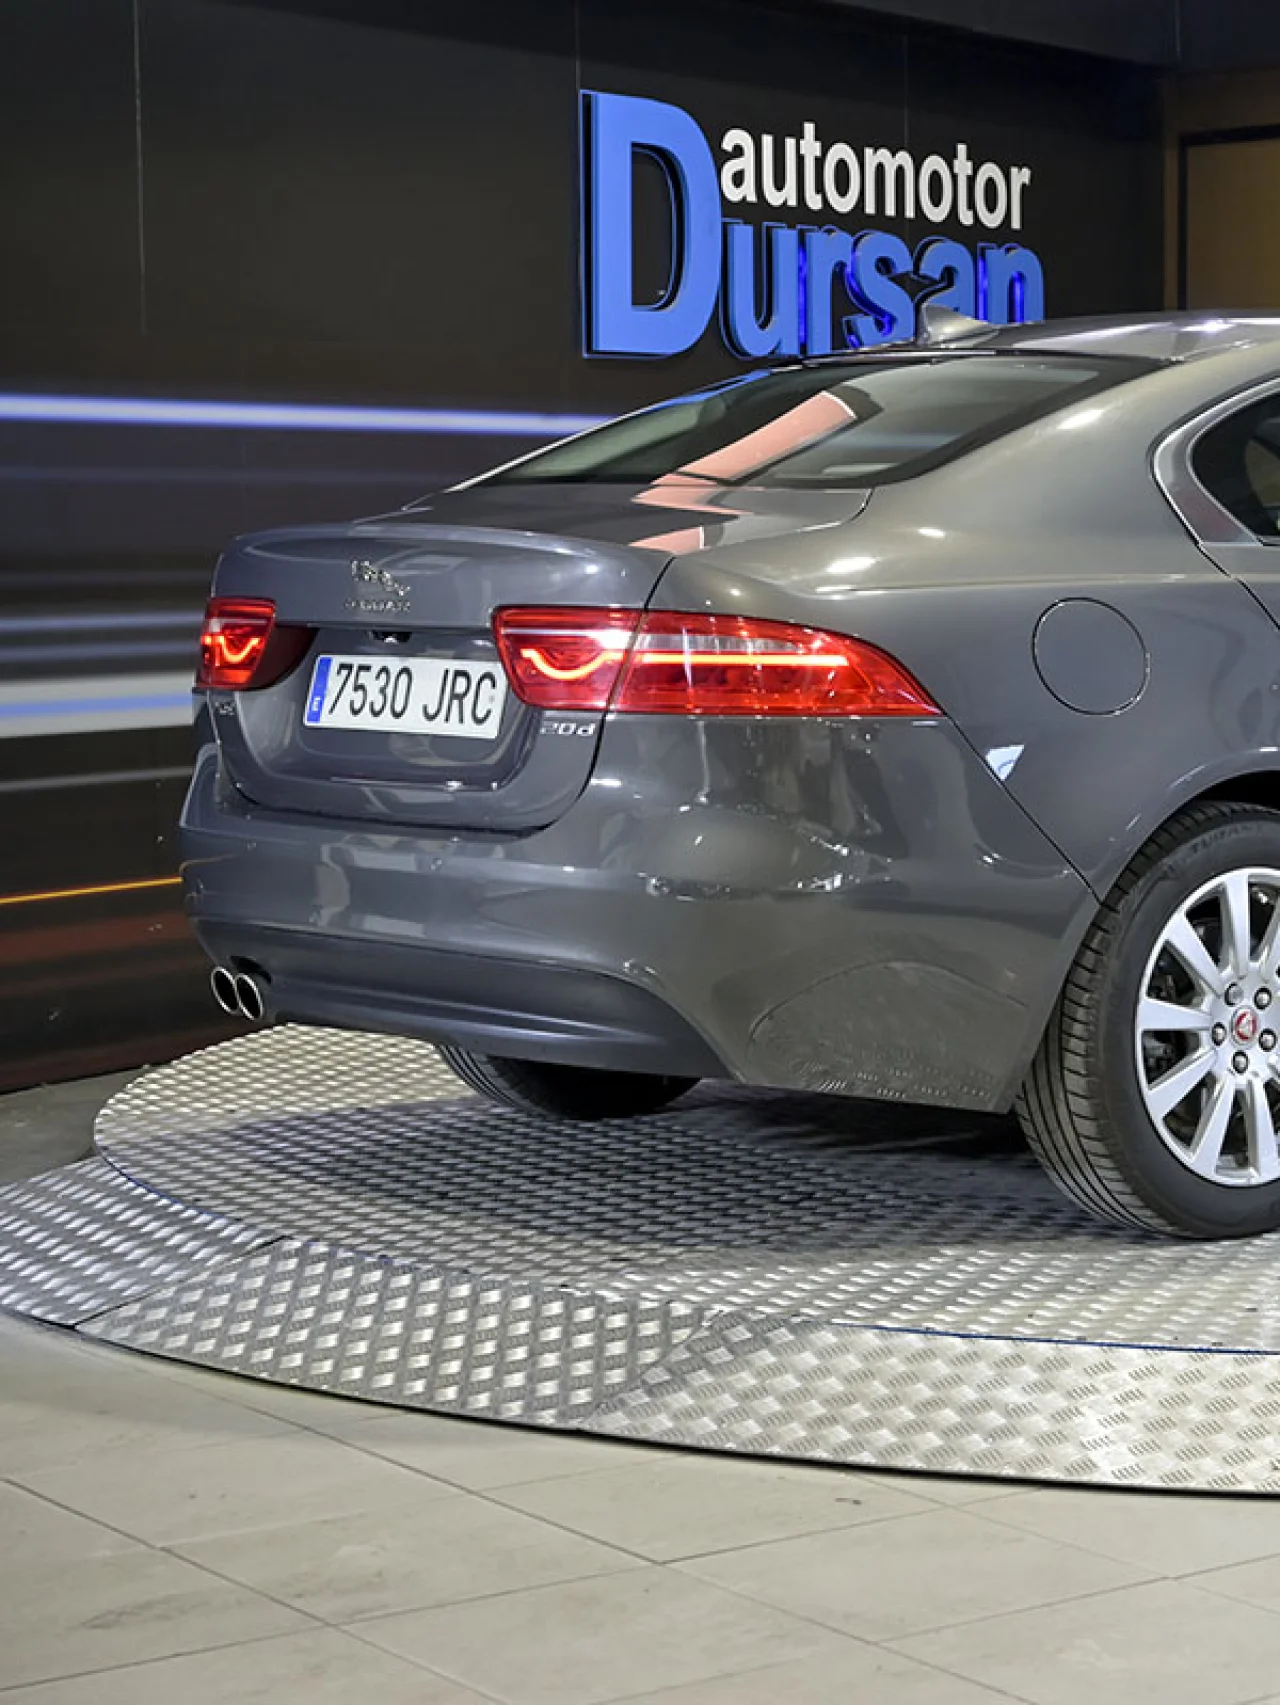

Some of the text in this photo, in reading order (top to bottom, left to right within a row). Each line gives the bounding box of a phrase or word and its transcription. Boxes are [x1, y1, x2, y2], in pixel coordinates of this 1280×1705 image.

[579, 89, 1045, 360] Dursan
[720, 121, 1032, 231] automotor
[328, 663, 497, 725] 7530 JRC
